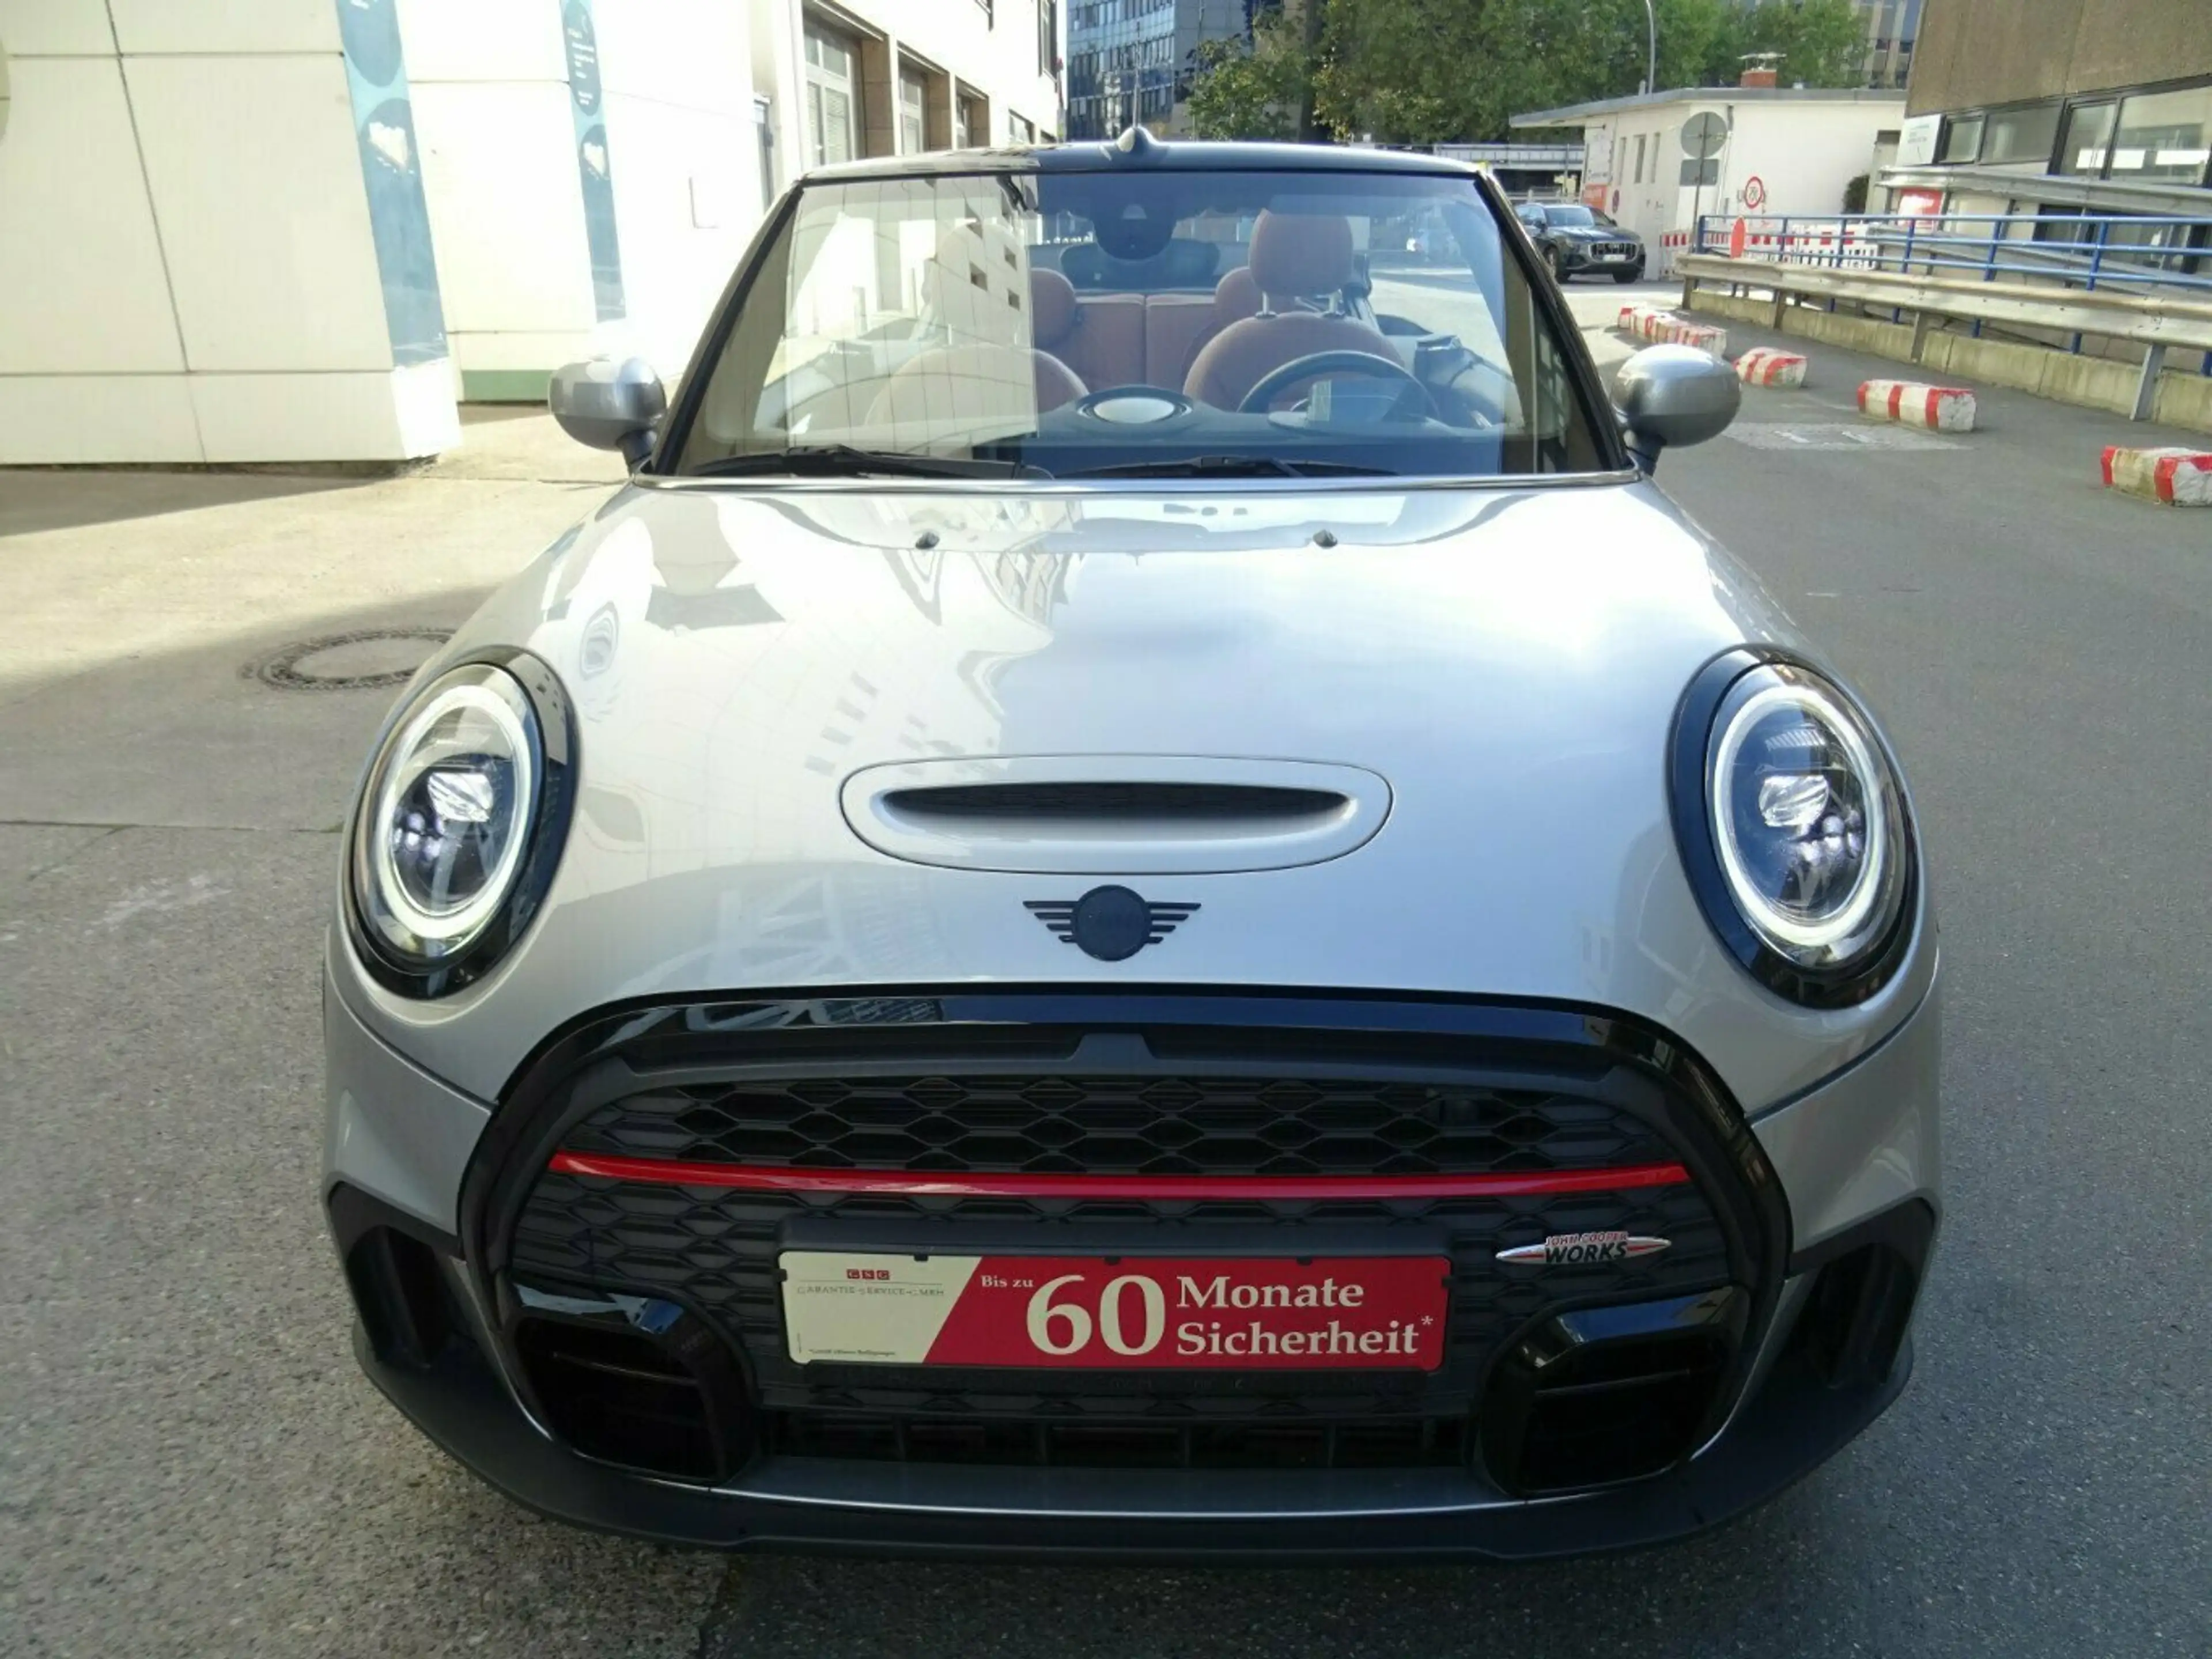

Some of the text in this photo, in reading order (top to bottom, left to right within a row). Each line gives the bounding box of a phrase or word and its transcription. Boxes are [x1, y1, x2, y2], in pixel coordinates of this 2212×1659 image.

[1580, 1232, 1628, 1243] COOPER
[1545, 1241, 1628, 1262] WORKS
[981, 1275, 1034, 1288] Bis zu
[1176, 1275, 1364, 1309] Monate
[1026, 1274, 1166, 1355] 60
